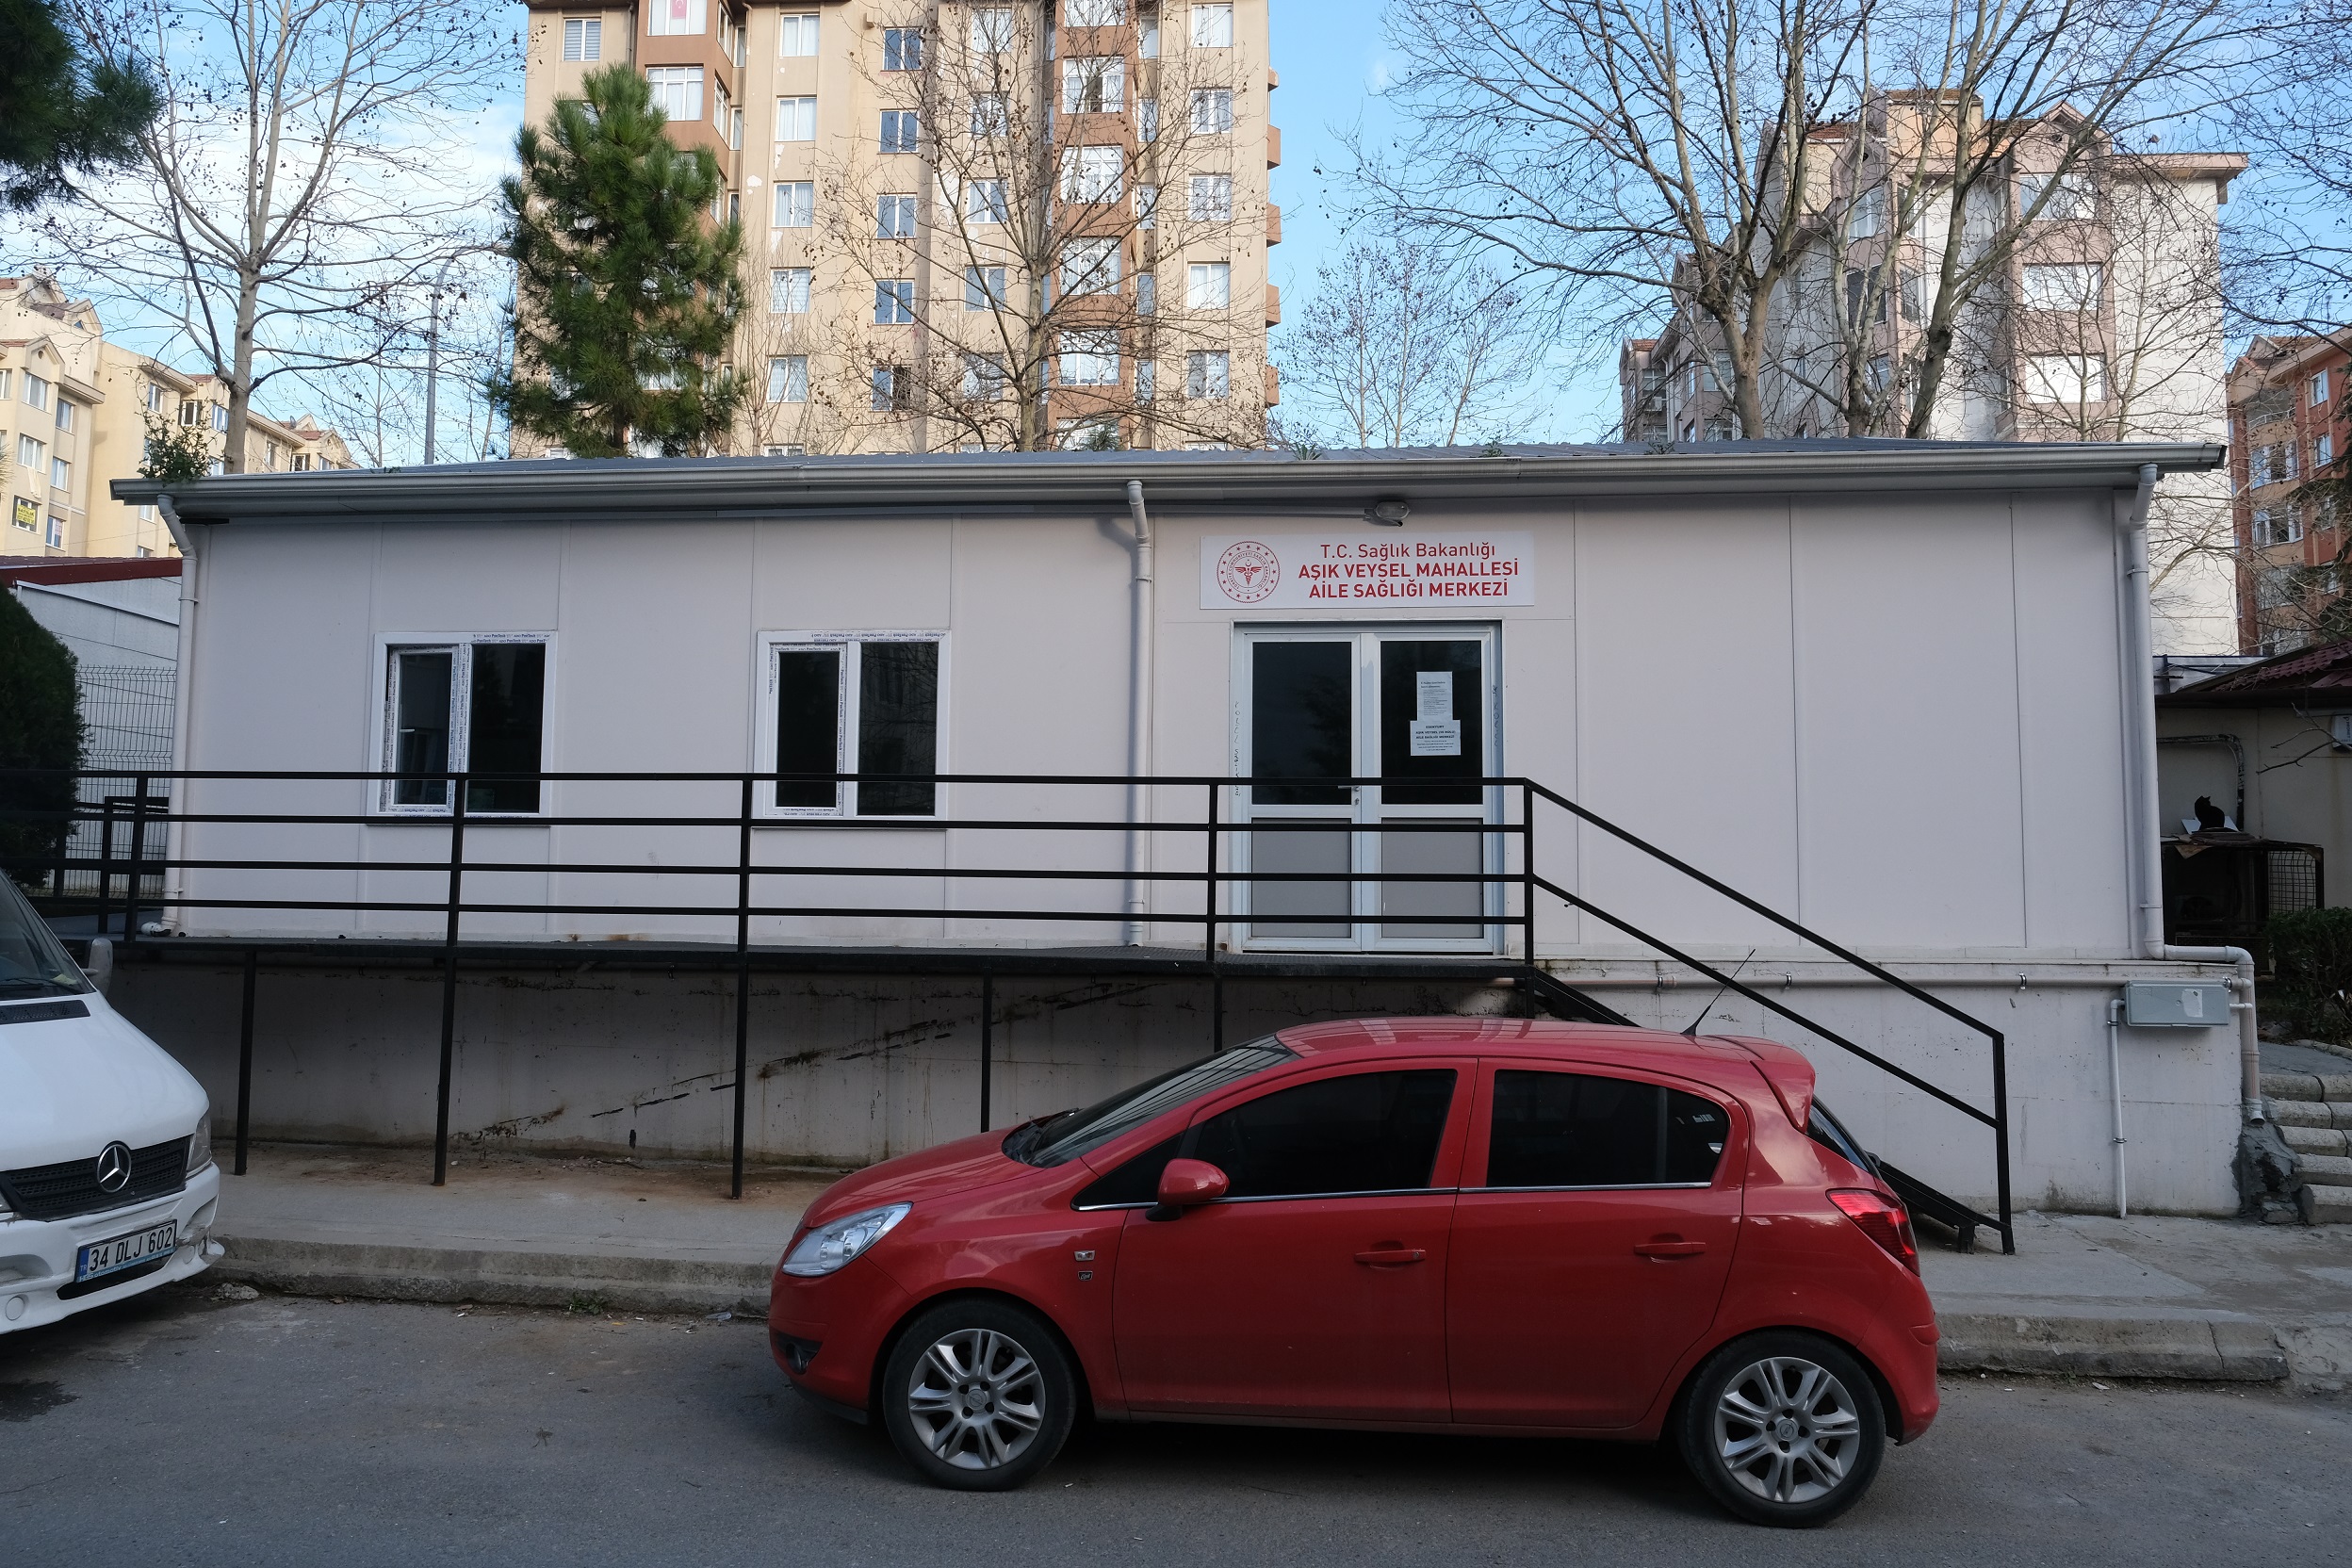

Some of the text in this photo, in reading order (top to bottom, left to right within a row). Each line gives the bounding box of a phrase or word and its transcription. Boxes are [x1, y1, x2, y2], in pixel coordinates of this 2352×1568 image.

[1320, 542, 1495, 562] T.C. Sağlık Bakanlığı
[1298, 558, 1518, 580] AŞIK VEYSEL MAHALLESİ
[1309, 578, 1508, 598] AİLE SAĞLIĞI MERKEZİ
[90, 1246, 109, 1272] 34
[115, 1235, 143, 1265] DLJ
[148, 1227, 172, 1253] 602
[80, 1264, 88, 1272] TR
